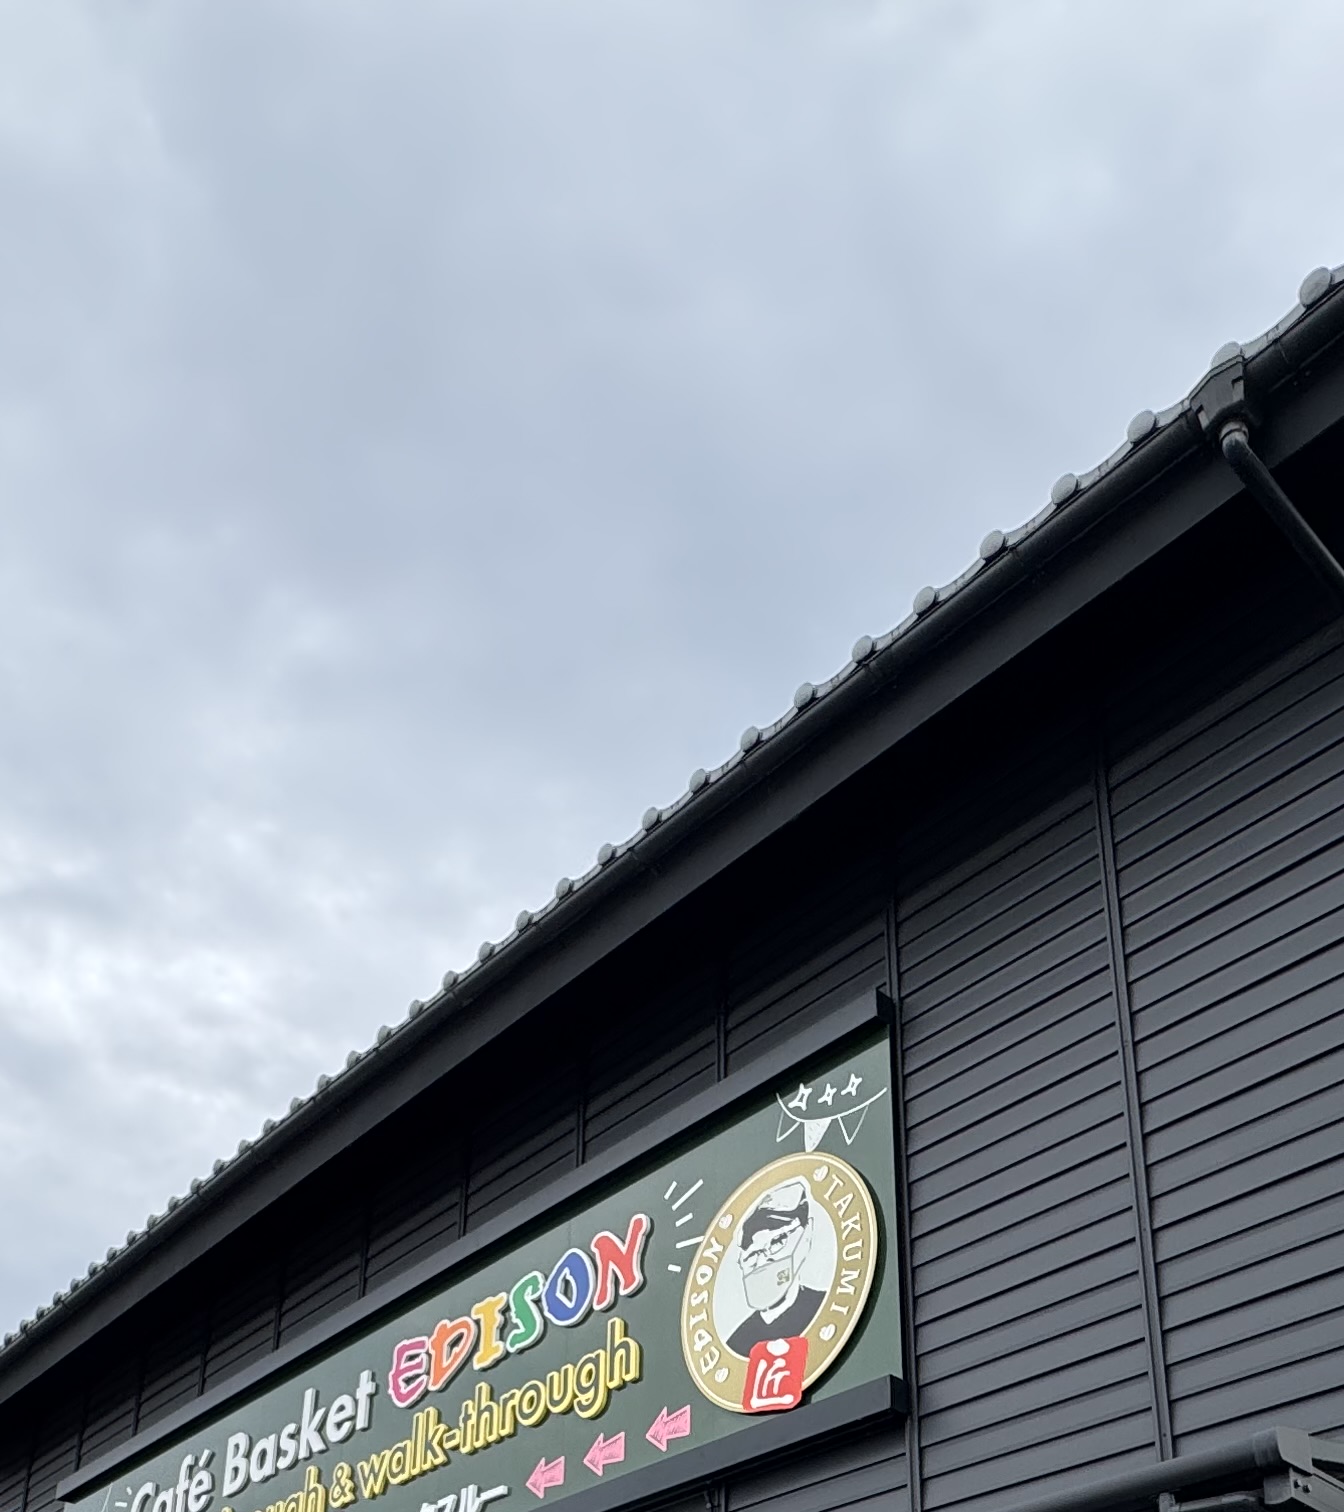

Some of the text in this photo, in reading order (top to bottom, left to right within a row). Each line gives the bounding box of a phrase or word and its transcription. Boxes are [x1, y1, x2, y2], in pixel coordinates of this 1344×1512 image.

[690, 1237, 725, 1375] EDISON
[823, 1174, 864, 1317] TAKUMI
[222, 1369, 379, 1498] Basket
[389, 1213, 650, 1408] EDISON
[329, 1462, 354, 1508] &
[358, 1317, 641, 1499] walk-through
[751, 1357, 794, 1409] 匠
